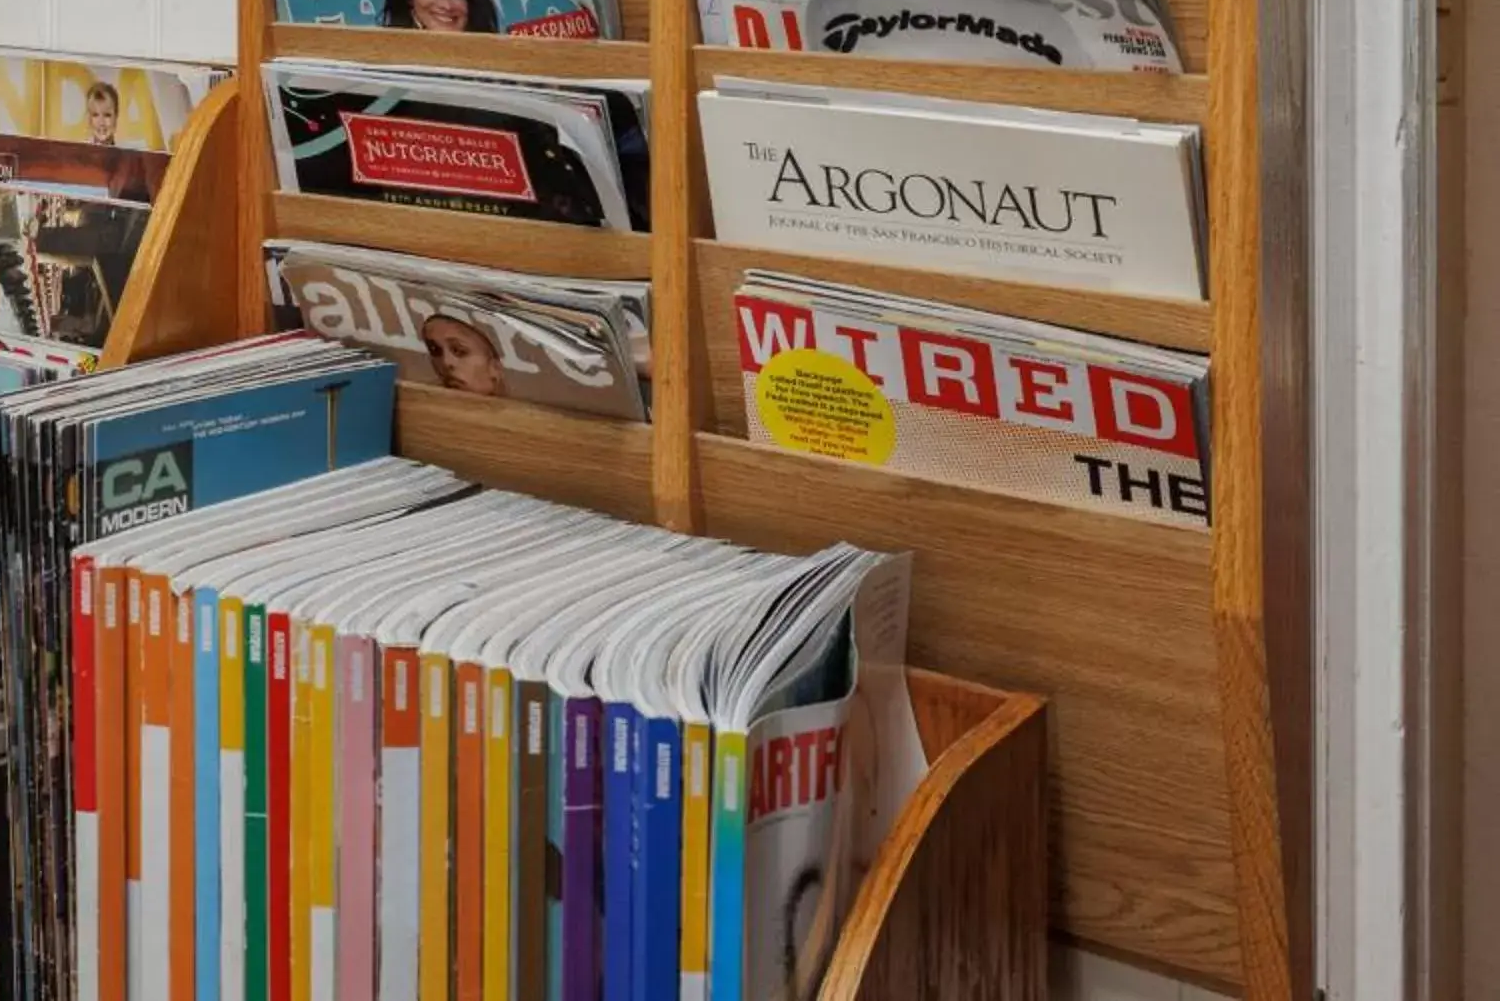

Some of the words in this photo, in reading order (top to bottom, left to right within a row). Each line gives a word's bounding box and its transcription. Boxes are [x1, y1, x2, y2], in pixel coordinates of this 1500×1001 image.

[822, 10, 1063, 66] TaylorMade
[364, 139, 517, 179] NUTCRACKER
[743, 141, 778, 163] THE
[768, 148, 1117, 238] ARGONAUT
[739, 306, 1178, 441] WIRED
[102, 450, 187, 510] CA
[1074, 454, 1209, 517] THE
[102, 495, 188, 534] MODERN
